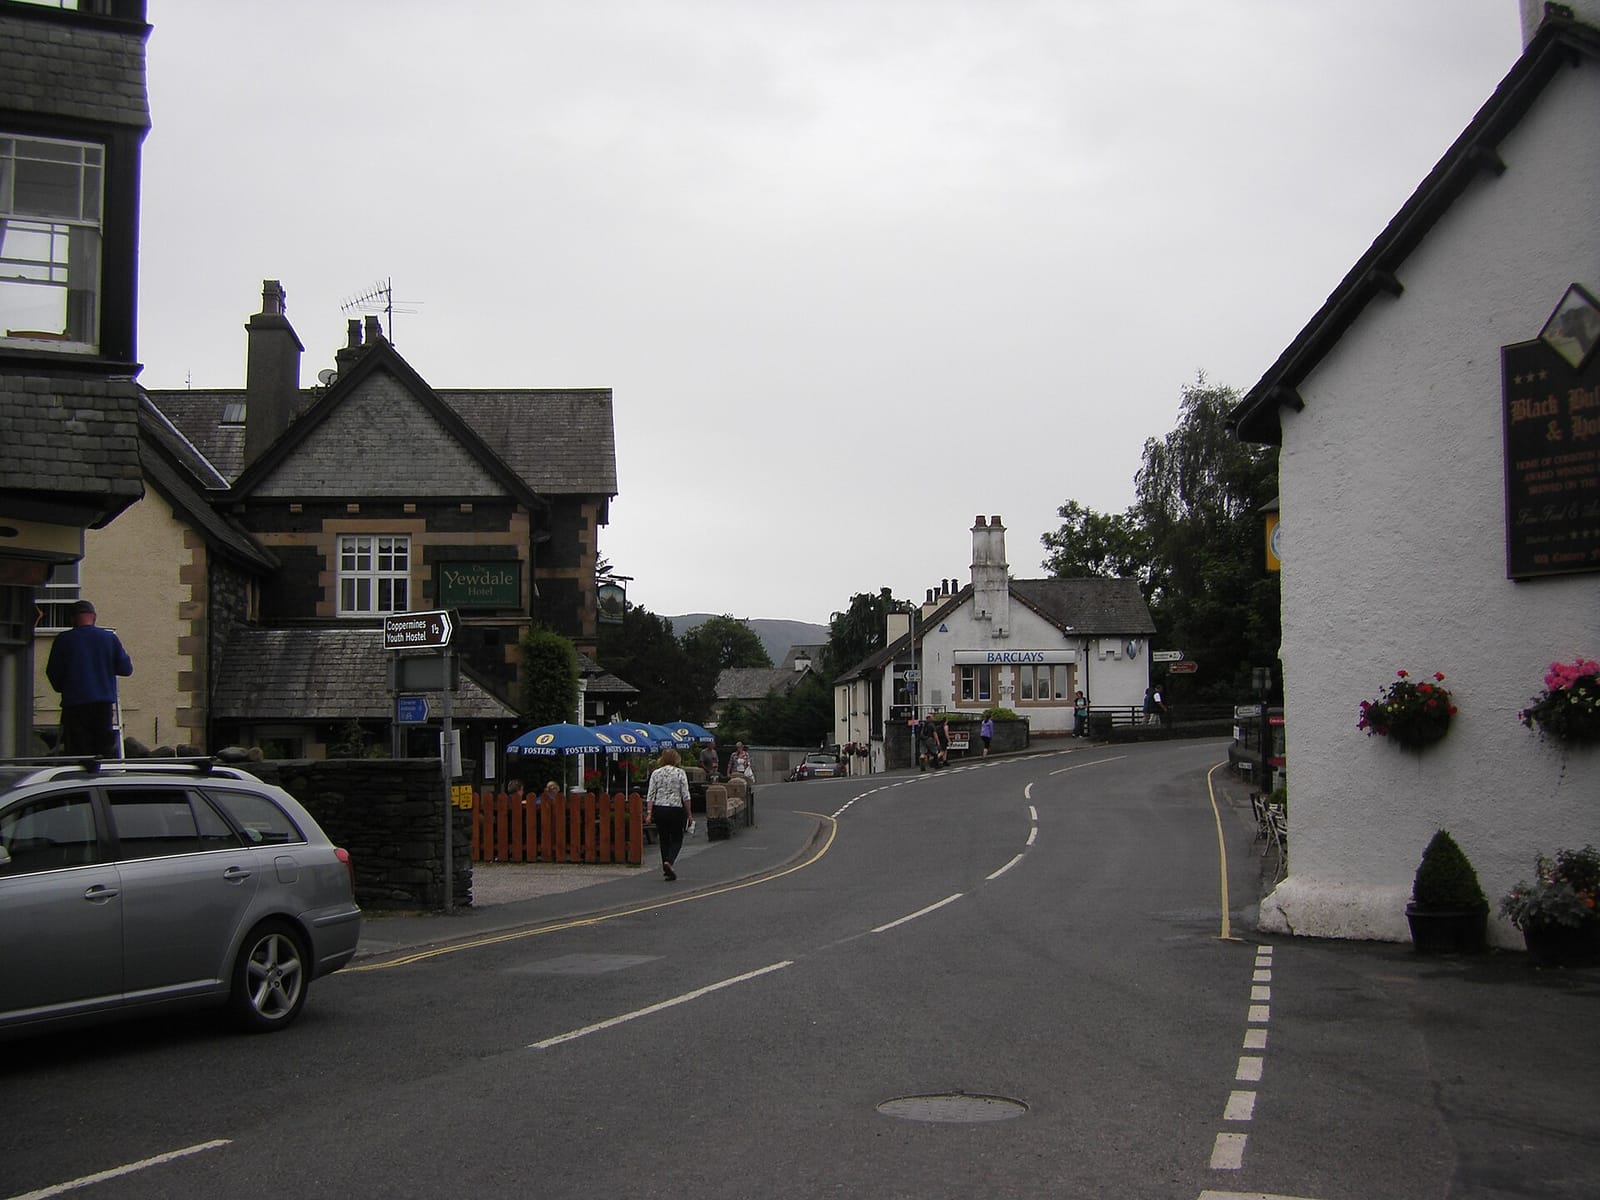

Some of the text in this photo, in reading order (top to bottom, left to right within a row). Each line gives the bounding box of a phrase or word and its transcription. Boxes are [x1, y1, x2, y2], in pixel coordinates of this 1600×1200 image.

[1511, 385, 1600, 425] Black Bul
[1546, 420, 1564, 441] &
[444, 571, 513, 589] Yewdale
[468, 587, 493, 597] Hotel
[387, 619, 427, 632] Coppermines
[387, 630, 427, 643] Youth Hostel
[987, 652, 1044, 663] BARCLAYS
[524, 747, 557, 756] FOSTER'S
[565, 746, 600, 755] FOSTER'S
